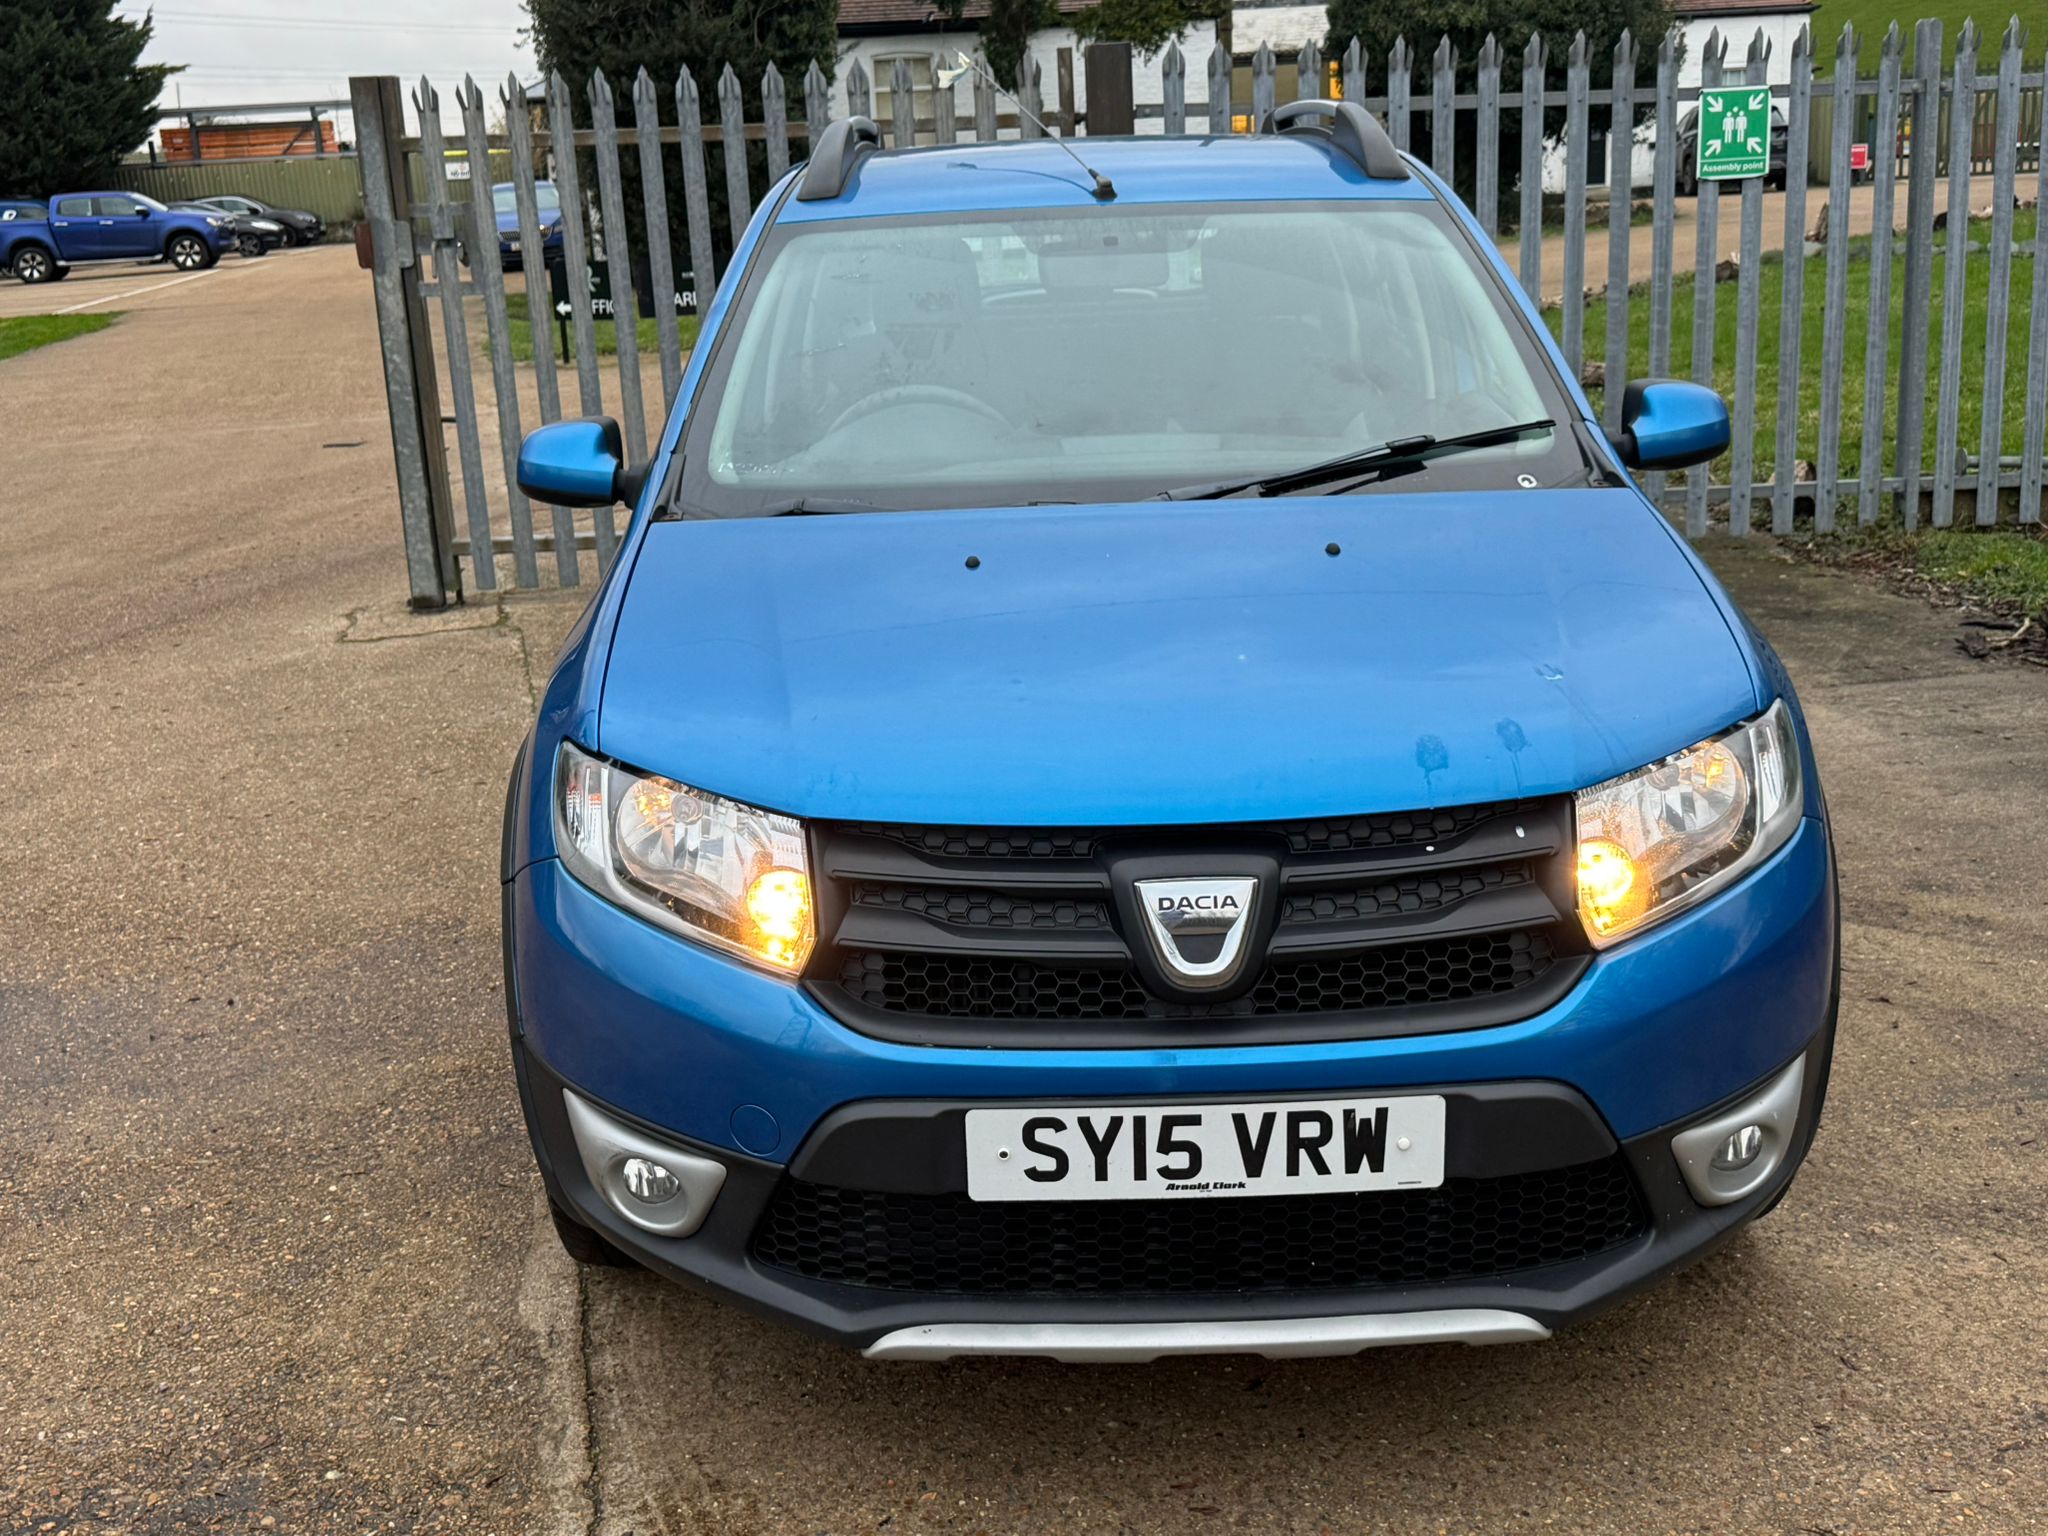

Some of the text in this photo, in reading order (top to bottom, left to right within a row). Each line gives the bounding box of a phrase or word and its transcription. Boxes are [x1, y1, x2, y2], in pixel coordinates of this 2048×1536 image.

[1702, 161, 1764, 173] Assembly point
[1158, 895, 1239, 911] DACIA
[1022, 1107, 1389, 1182] SY15 VRW
[1165, 1182, 1210, 1191] Arnold
[1212, 1181, 1246, 1190] Clark
